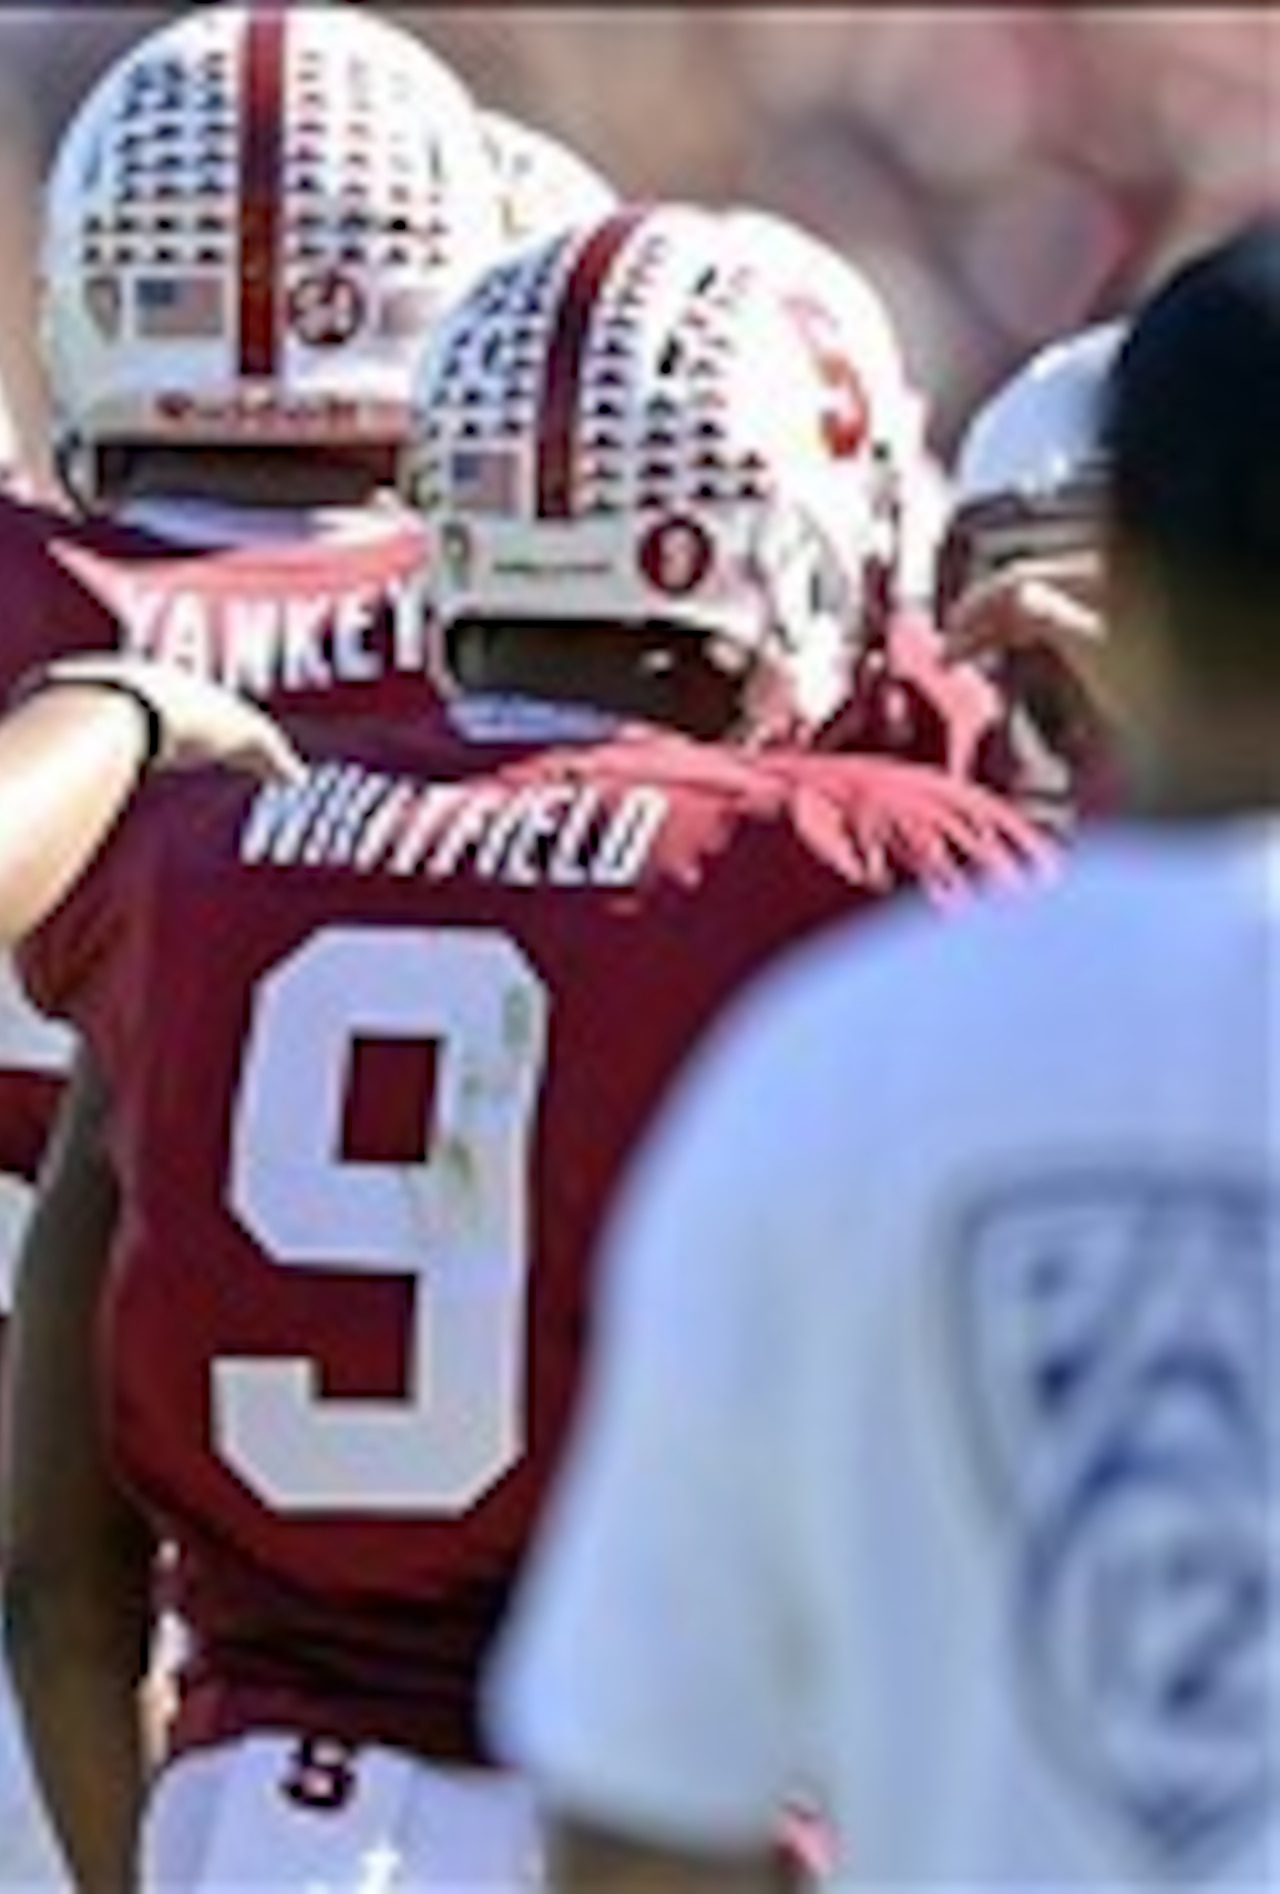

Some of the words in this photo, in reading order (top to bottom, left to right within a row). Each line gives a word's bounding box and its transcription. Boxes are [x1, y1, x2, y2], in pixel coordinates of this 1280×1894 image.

[122, 572, 426, 694] YANKEY
[240, 763, 670, 886] WHITFIELD
[209, 926, 549, 1515] 9
